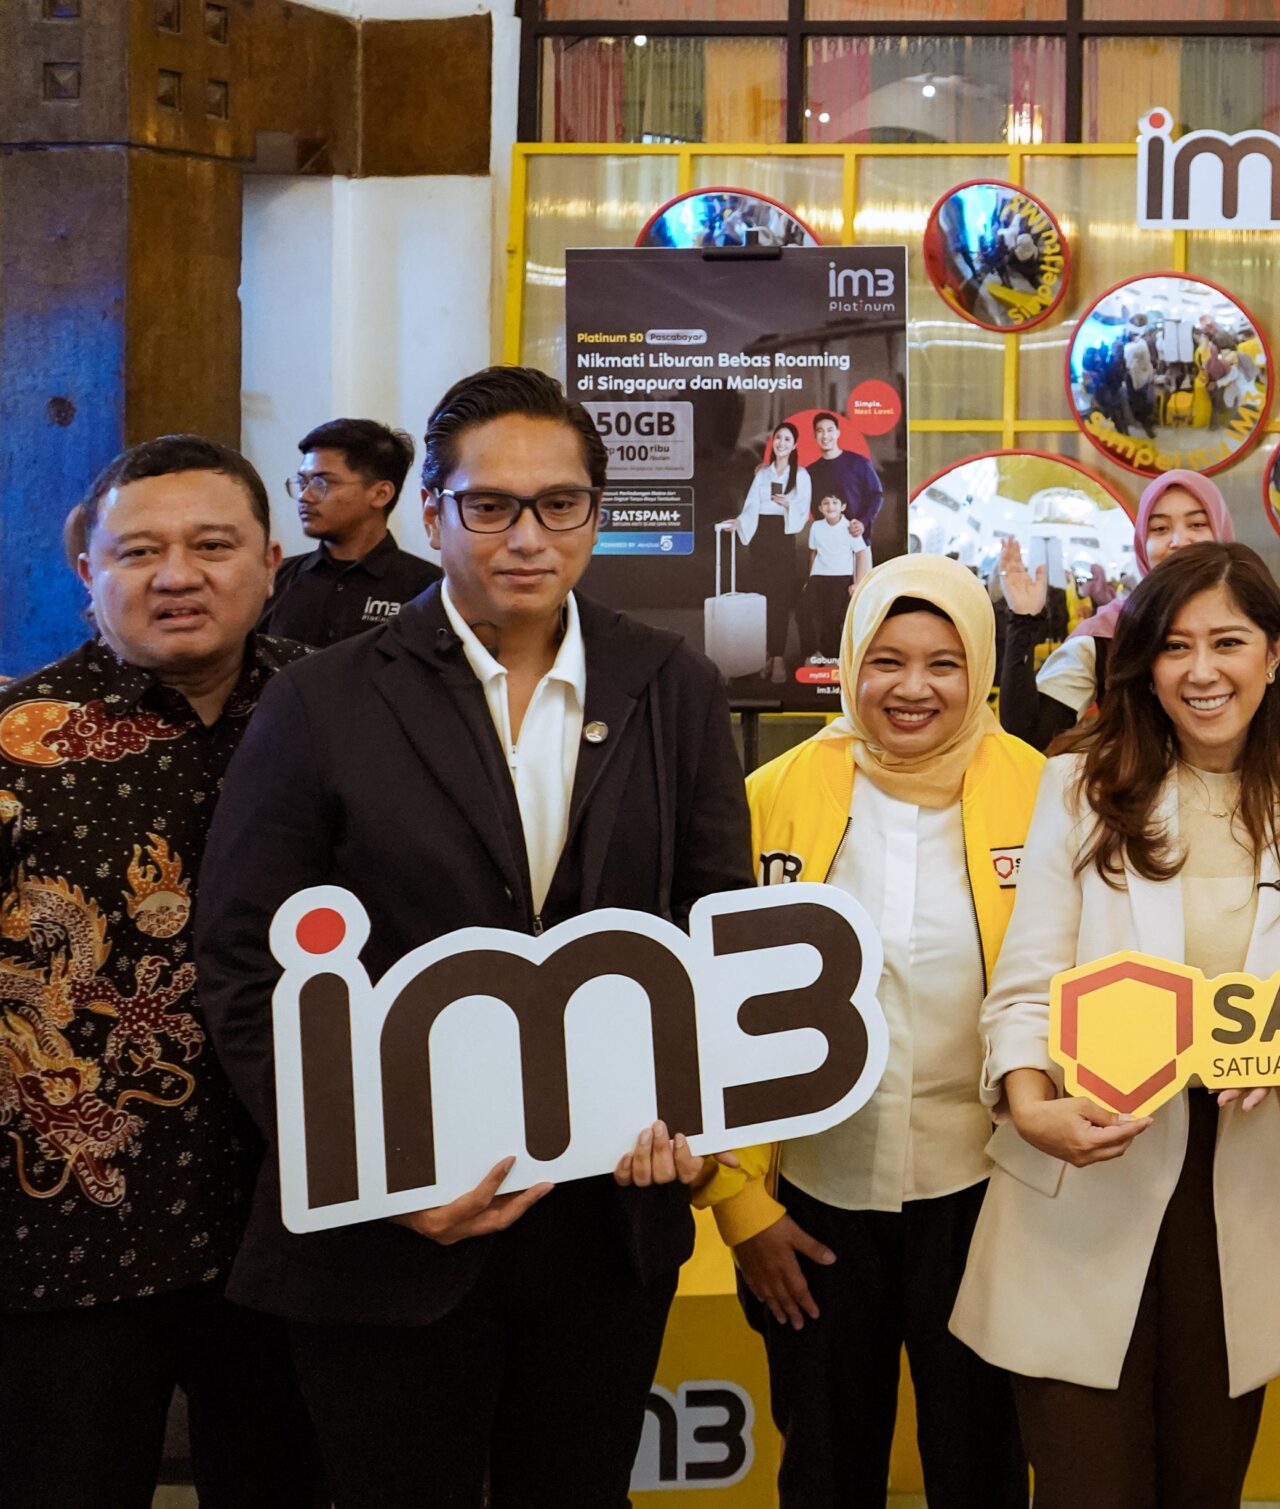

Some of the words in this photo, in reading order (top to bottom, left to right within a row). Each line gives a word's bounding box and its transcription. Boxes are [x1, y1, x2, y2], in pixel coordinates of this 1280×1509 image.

[829, 262, 894, 297] im3
[829, 299, 895, 311] Platinum
[577, 332, 627, 343] Platinum
[629, 332, 644, 343] 50
[650, 333, 703, 343] Pascabayar
[577, 353, 644, 367] Nikmati
[648, 353, 714, 367] Liburan
[718, 352, 771, 367] Bebas
[775, 352, 850, 371] Roaming
[577, 375, 594, 390] di
[597, 375, 686, 394] Singapura
[690, 375, 722, 389] dan
[727, 374, 803, 393] Malaysia
[596, 412, 675, 436] 50GB
[616, 445, 648, 461] 100
[650, 444, 670, 452] ribu
[612, 510, 681, 521] SATSPAM+
[364, 596, 401, 616] im3
[296, 902, 869, 1210] im3
